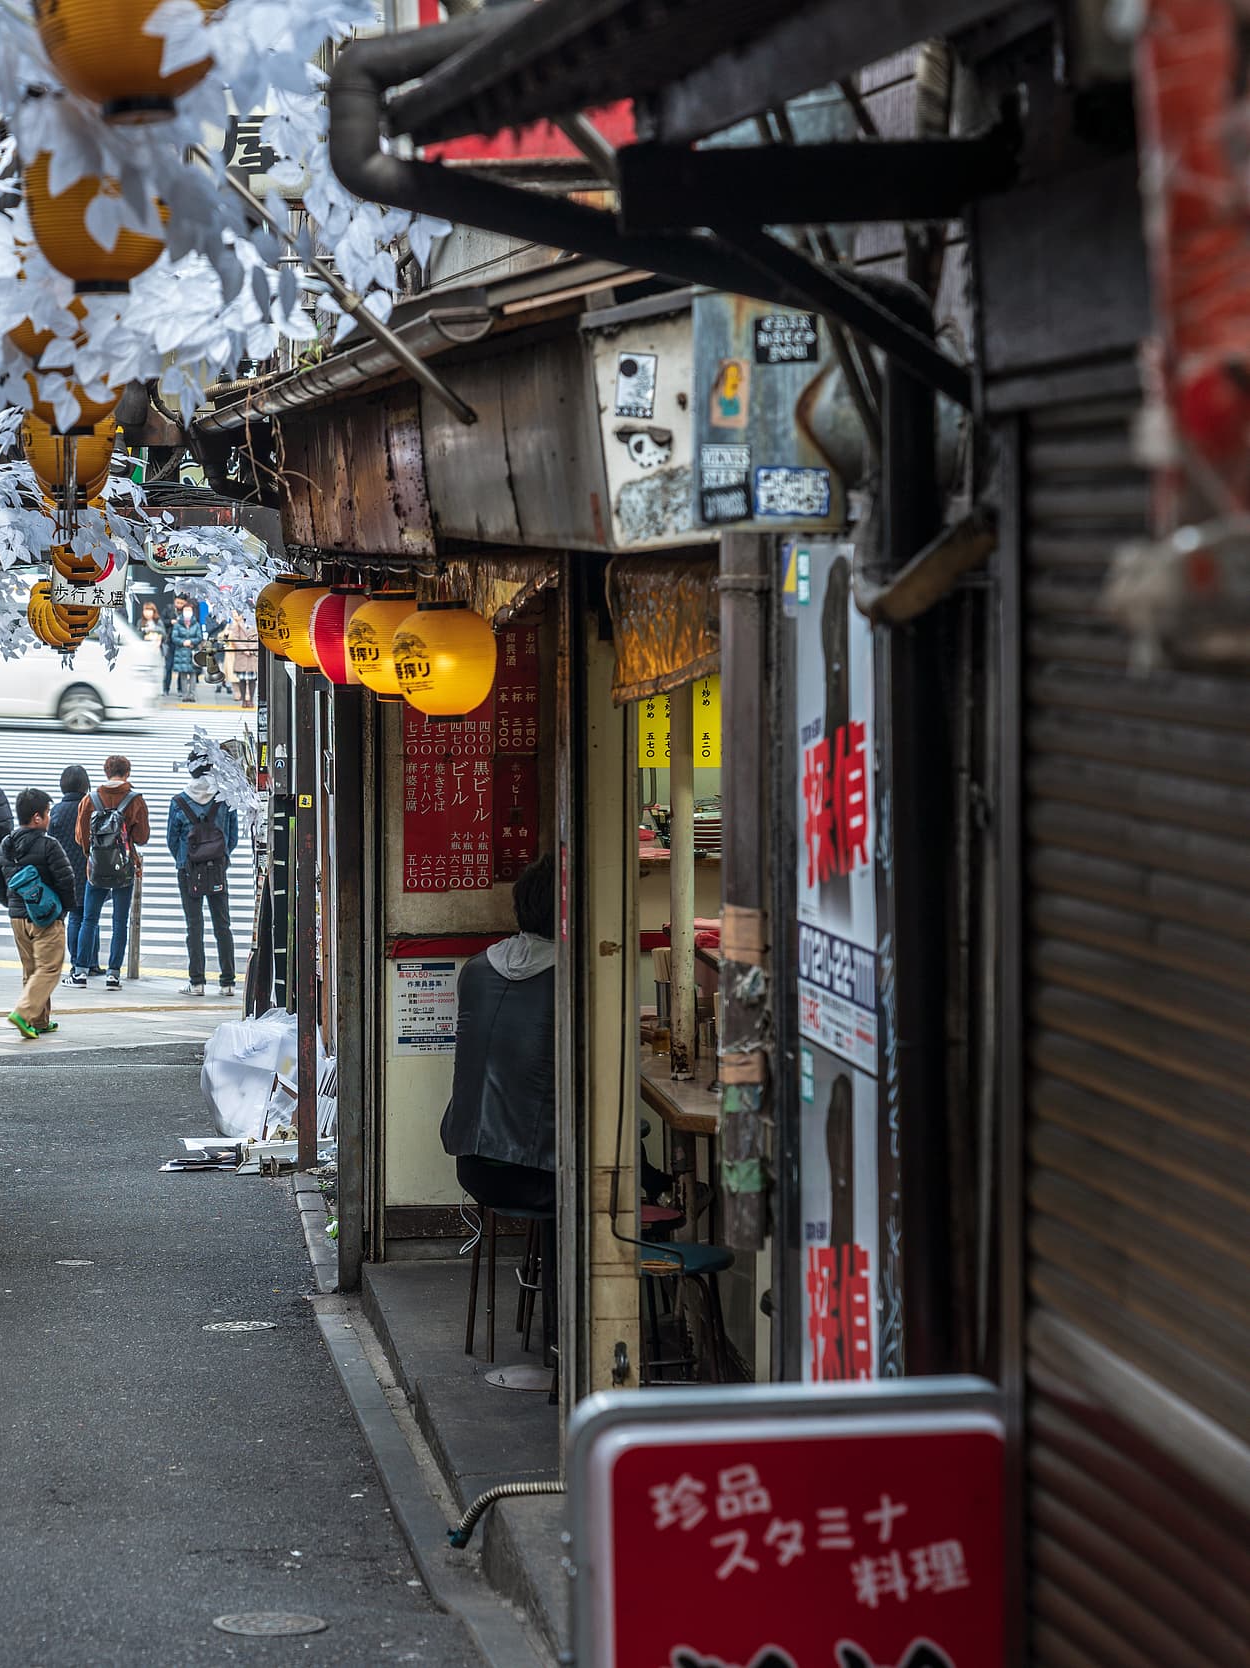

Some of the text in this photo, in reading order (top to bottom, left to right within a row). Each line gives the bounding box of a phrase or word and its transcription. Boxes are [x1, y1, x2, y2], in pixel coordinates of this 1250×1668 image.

[54, 584, 124, 606] 歩行禁煙
[526, 633, 535, 654] お酒
[526, 685, 536, 703] 一杯
[406, 721, 418, 755] 七二〇
[646, 732, 655, 757] 五七〇
[451, 761, 470, 806] ビール
[472, 761, 491, 823] 黒ビール
[405, 762, 418, 888] 麻婆豆腐 五七〇
[420, 762, 432, 888] チャーハン 六二〇
[433, 762, 446, 888] 焼きそば 六二〇
[502, 827, 512, 838] 黒
[519, 827, 528, 837] 白
[449, 854, 461, 889] 六三〇
[462, 853, 474, 888] 四五〇
[476, 854, 489, 888] 四五〇
[649, 1463, 771, 1531] 珍品
[710, 1494, 908, 1580] スタミナ
[851, 1538, 970, 1608] 料理
